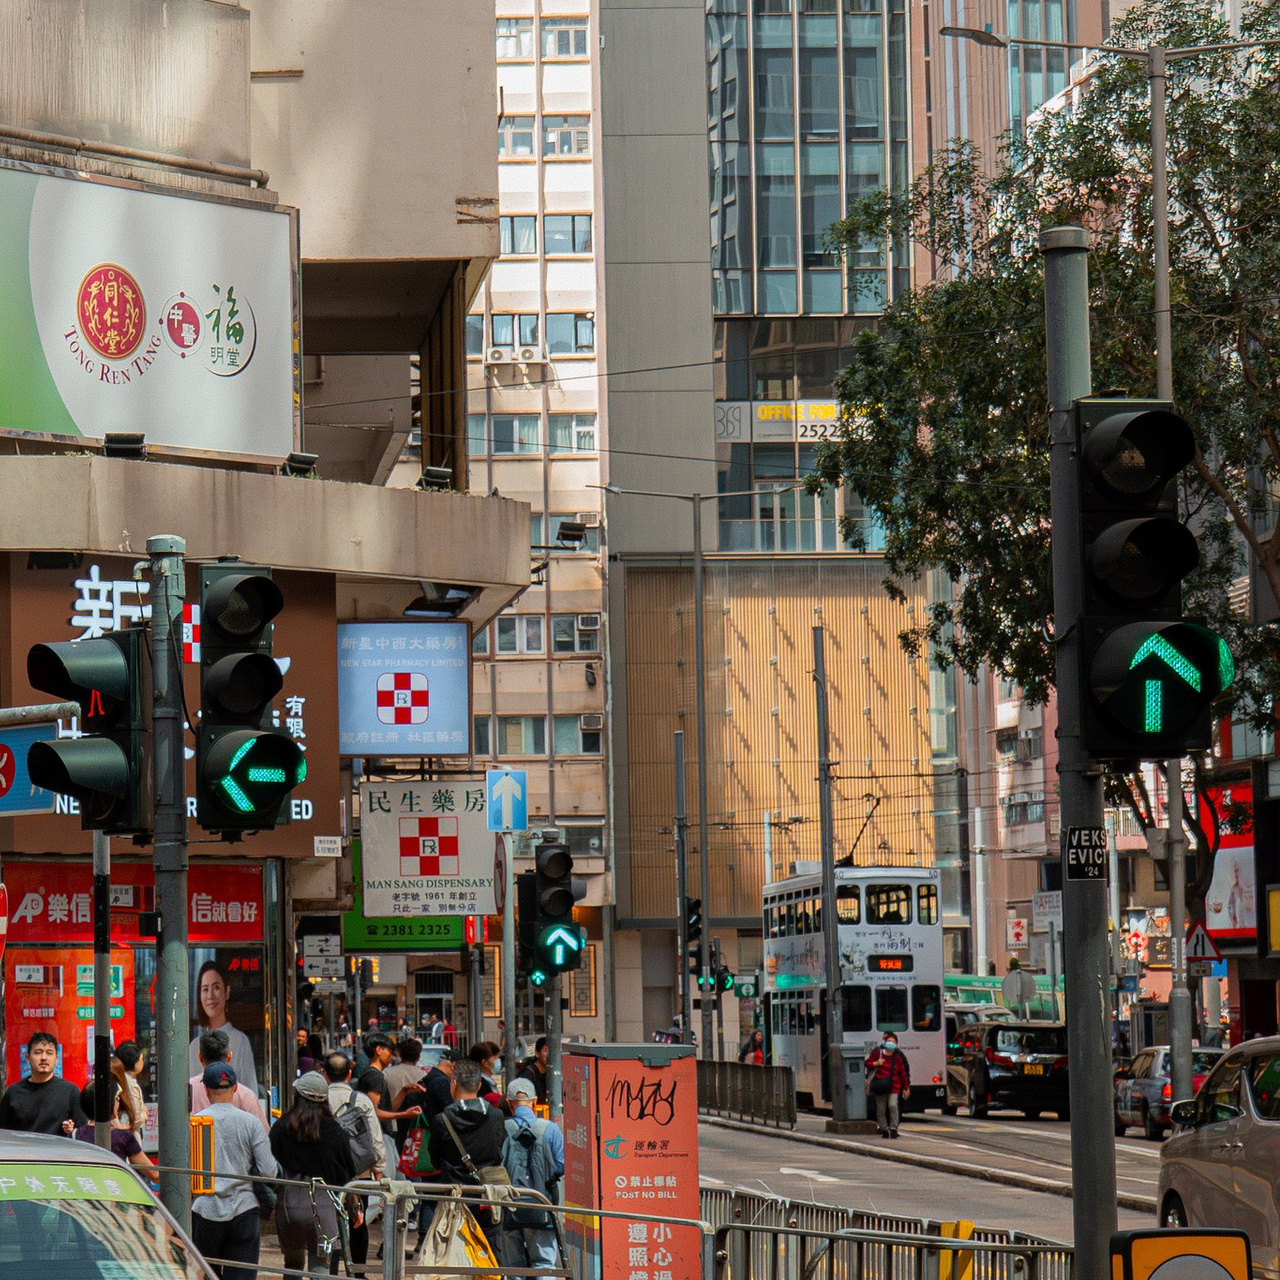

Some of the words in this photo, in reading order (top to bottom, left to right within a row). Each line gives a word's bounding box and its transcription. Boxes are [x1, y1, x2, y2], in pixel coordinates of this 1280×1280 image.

[104, 281, 121, 353] 同仁堂
[757, 404, 804, 420] OFFICE
[809, 404, 836, 420] FOR
[341, 659, 360, 667] NEW
[362, 659, 383, 667] STAR
[385, 659, 430, 667] PHARMACY
[432, 658, 465, 667] LIMITED
[56, 795, 80, 814] NE
[368, 788, 486, 814] 民生藥房
[366, 880, 392, 889] MAN
[394, 879, 424, 889] SANG
[426, 878, 494, 889] DISPENSARY
[425, 892, 445, 900] 1961
[48, 893, 91, 924] 樂信
[191, 892, 258, 923] 信就會好
[383, 924, 414, 936] 2381
[419, 924, 451, 935] 2325
[634, 1140, 670, 1151] 運輸署
[615, 1191, 639, 1199] POST
[642, 1191, 655, 1199] NO
[658, 1191, 677, 1199] BILL
